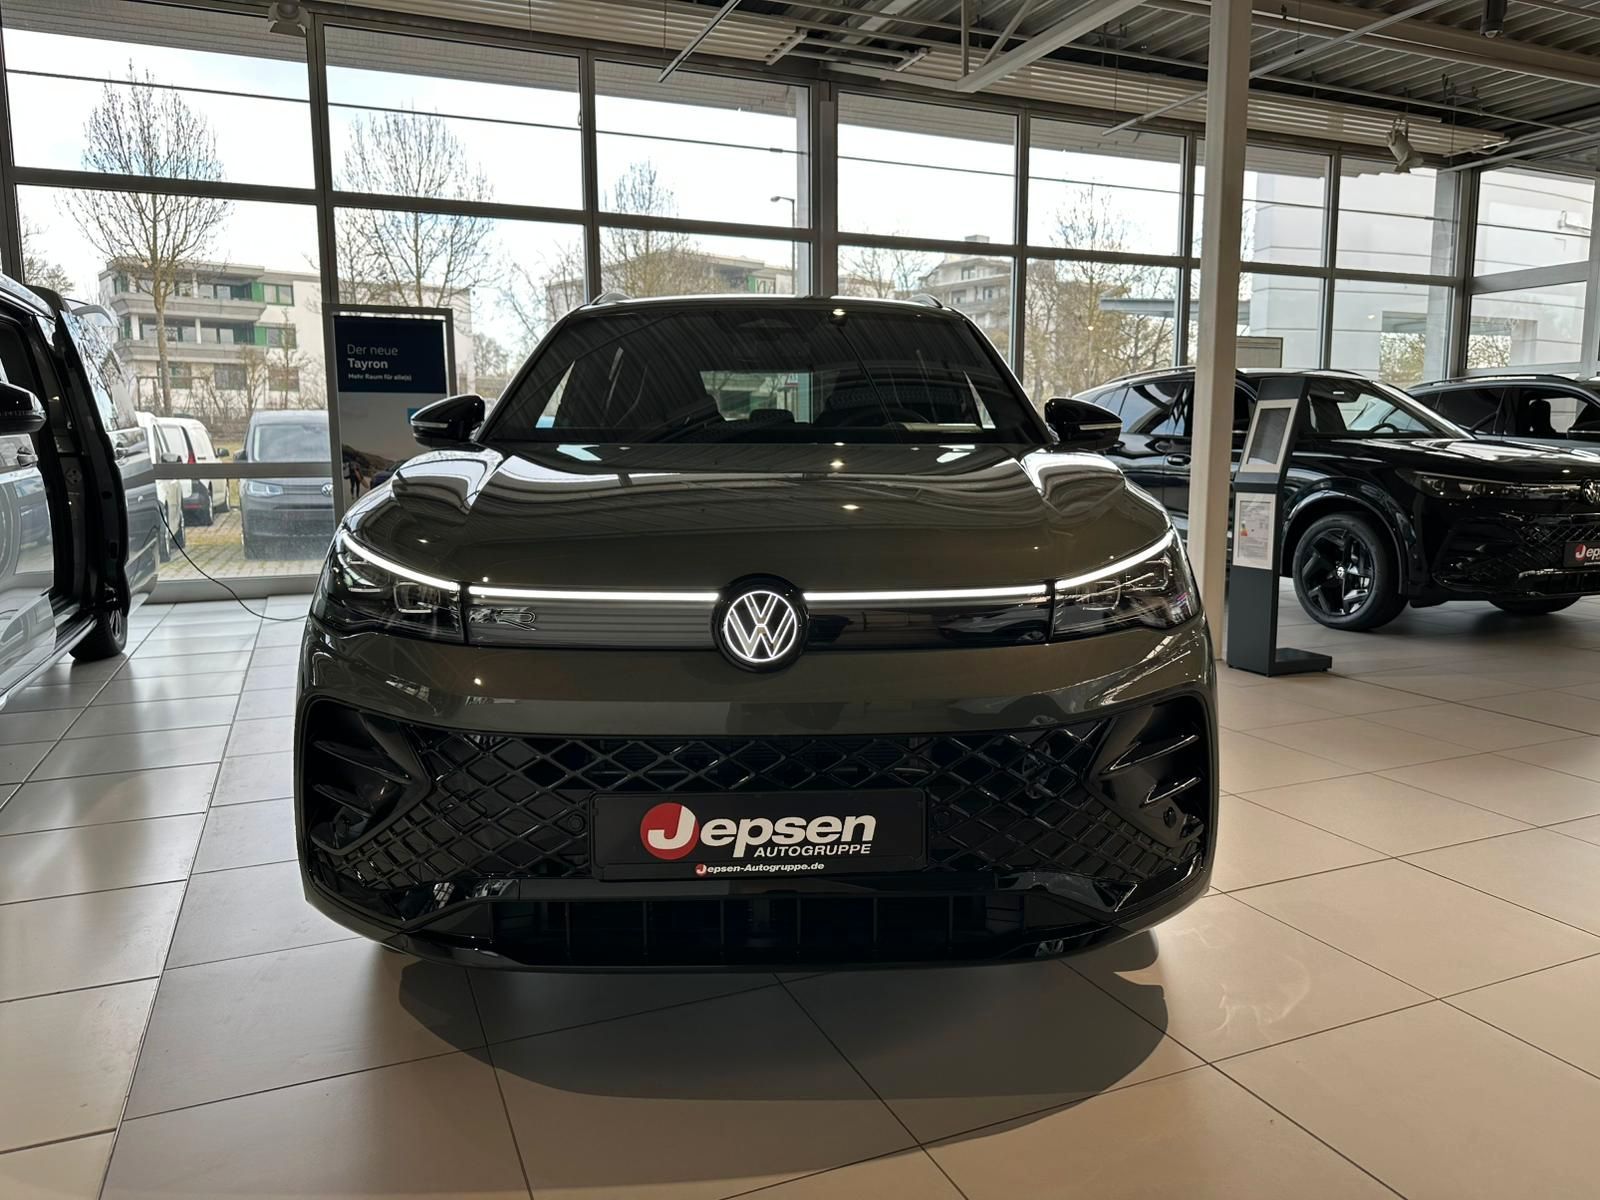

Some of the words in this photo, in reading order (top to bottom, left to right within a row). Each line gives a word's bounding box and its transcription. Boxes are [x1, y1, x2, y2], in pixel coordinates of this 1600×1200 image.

[347, 343, 367, 355] Der
[370, 346, 399, 356] neue
[347, 357, 389, 371] Tayron
[647, 804, 877, 858] Jepsen
[753, 843, 872, 858] AUTOGRUPPE
[696, 862, 825, 876] Jepsen-Autogruppe.de
